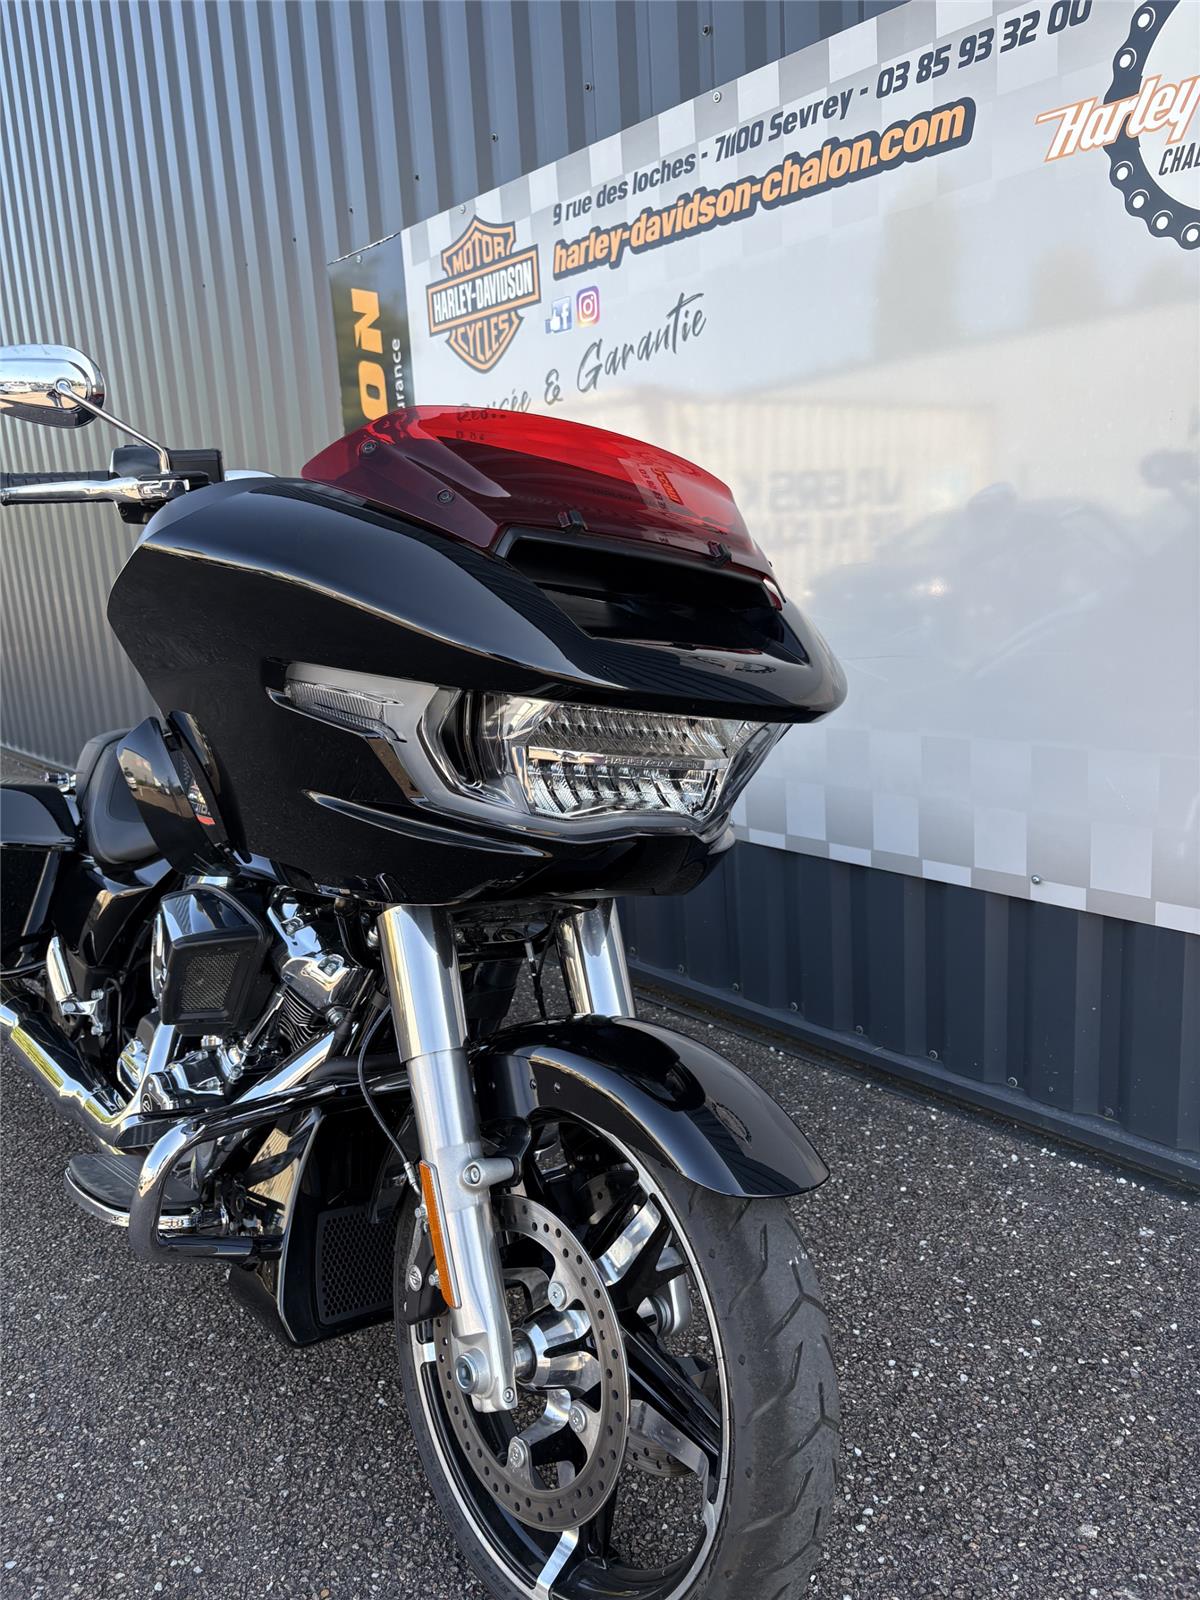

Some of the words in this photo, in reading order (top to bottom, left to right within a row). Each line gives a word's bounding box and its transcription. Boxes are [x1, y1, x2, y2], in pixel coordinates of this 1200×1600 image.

[553, 202, 562, 225] 9
[565, 195, 592, 221] rue
[596, 180, 629, 209] des
[632, 153, 697, 195] loches
[715, 119, 763, 163] 71100
[768, 88, 854, 142] Sevrey
[875, 61, 911, 99] 03
[916, 43, 952, 84] 85
[957, 27, 995, 69] 93
[1000, 10, 1041, 53] 32
[1046, 0, 1093, 35] 00
[1034, 74, 1200, 163] Harley
[552, 100, 970, 277] harley-davidson-chalon.com
[433, 260, 534, 324] HARLEY-DAVIDSON
[451, 230, 506, 275] MOTOR
[456, 313, 510, 363] CYCLES
[543, 368, 565, 406] &
[577, 292, 707, 394] Garantie
